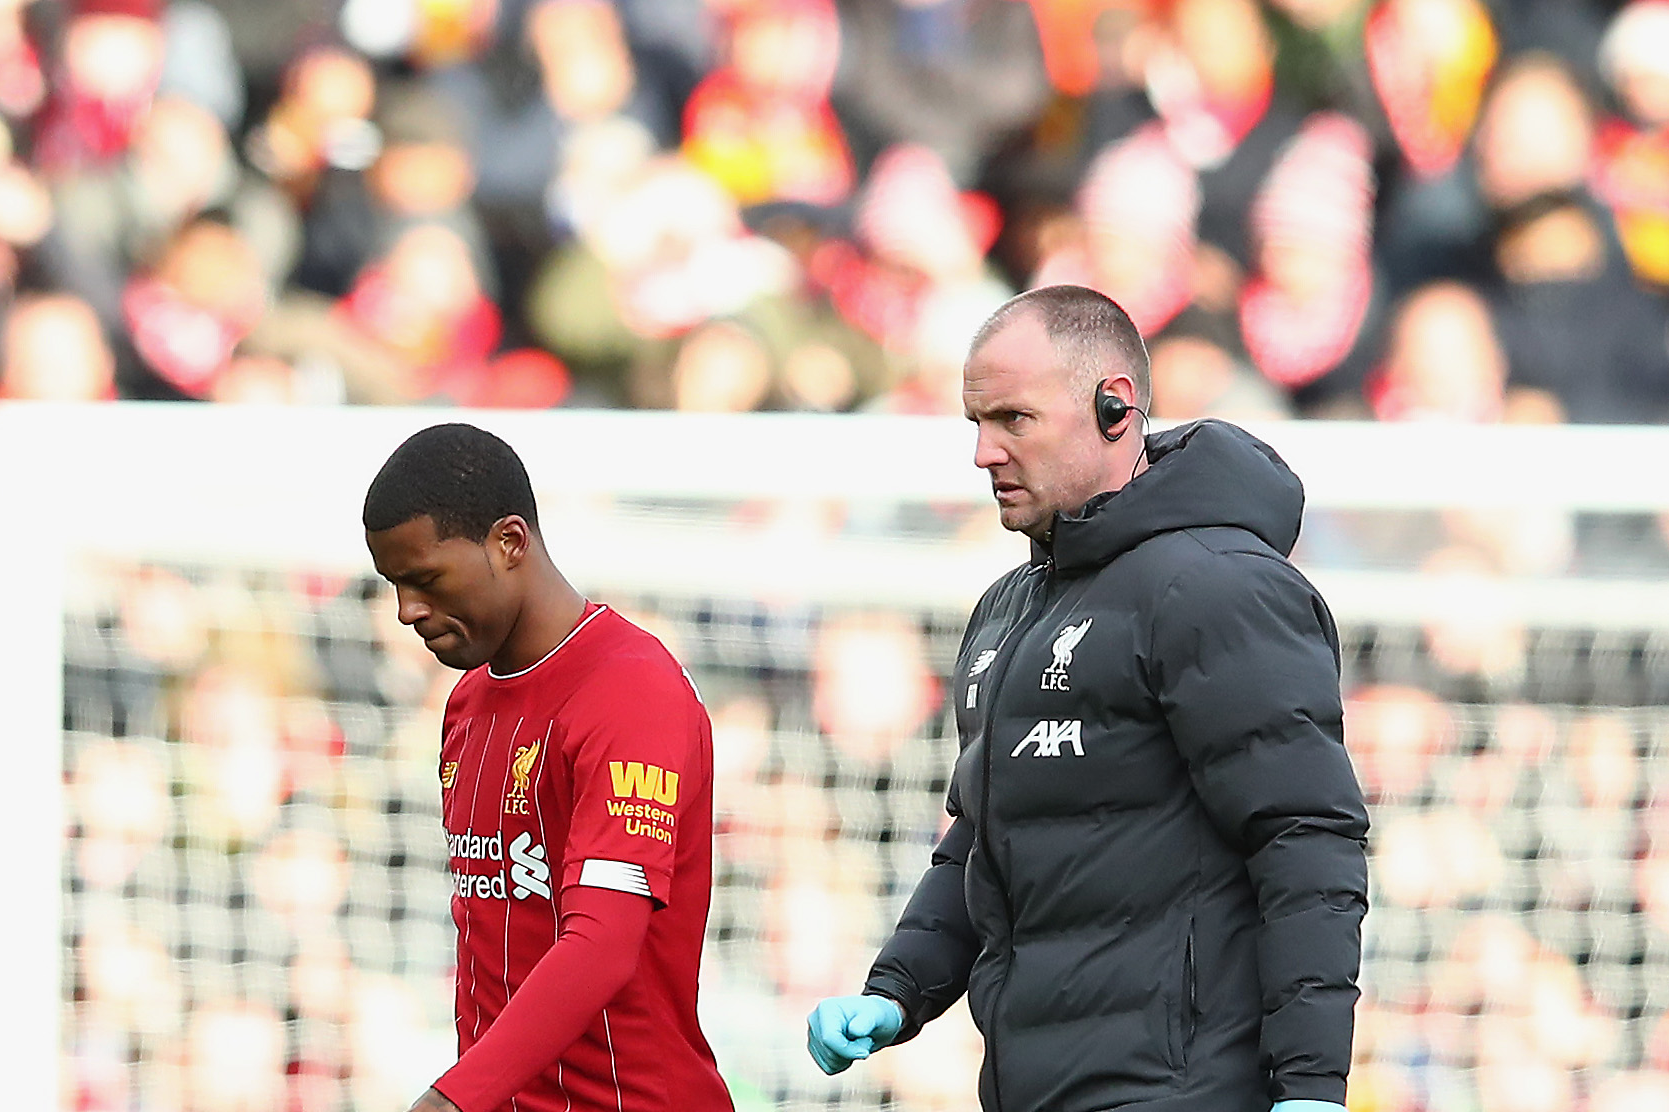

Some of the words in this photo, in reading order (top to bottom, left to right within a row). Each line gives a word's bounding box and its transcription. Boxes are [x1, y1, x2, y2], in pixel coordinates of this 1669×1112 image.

[1010, 720, 1085, 757] AXA
[609, 761, 679, 807] WU
[606, 799, 675, 827] Western
[445, 827, 504, 861] andard
[625, 817, 672, 845] Union
